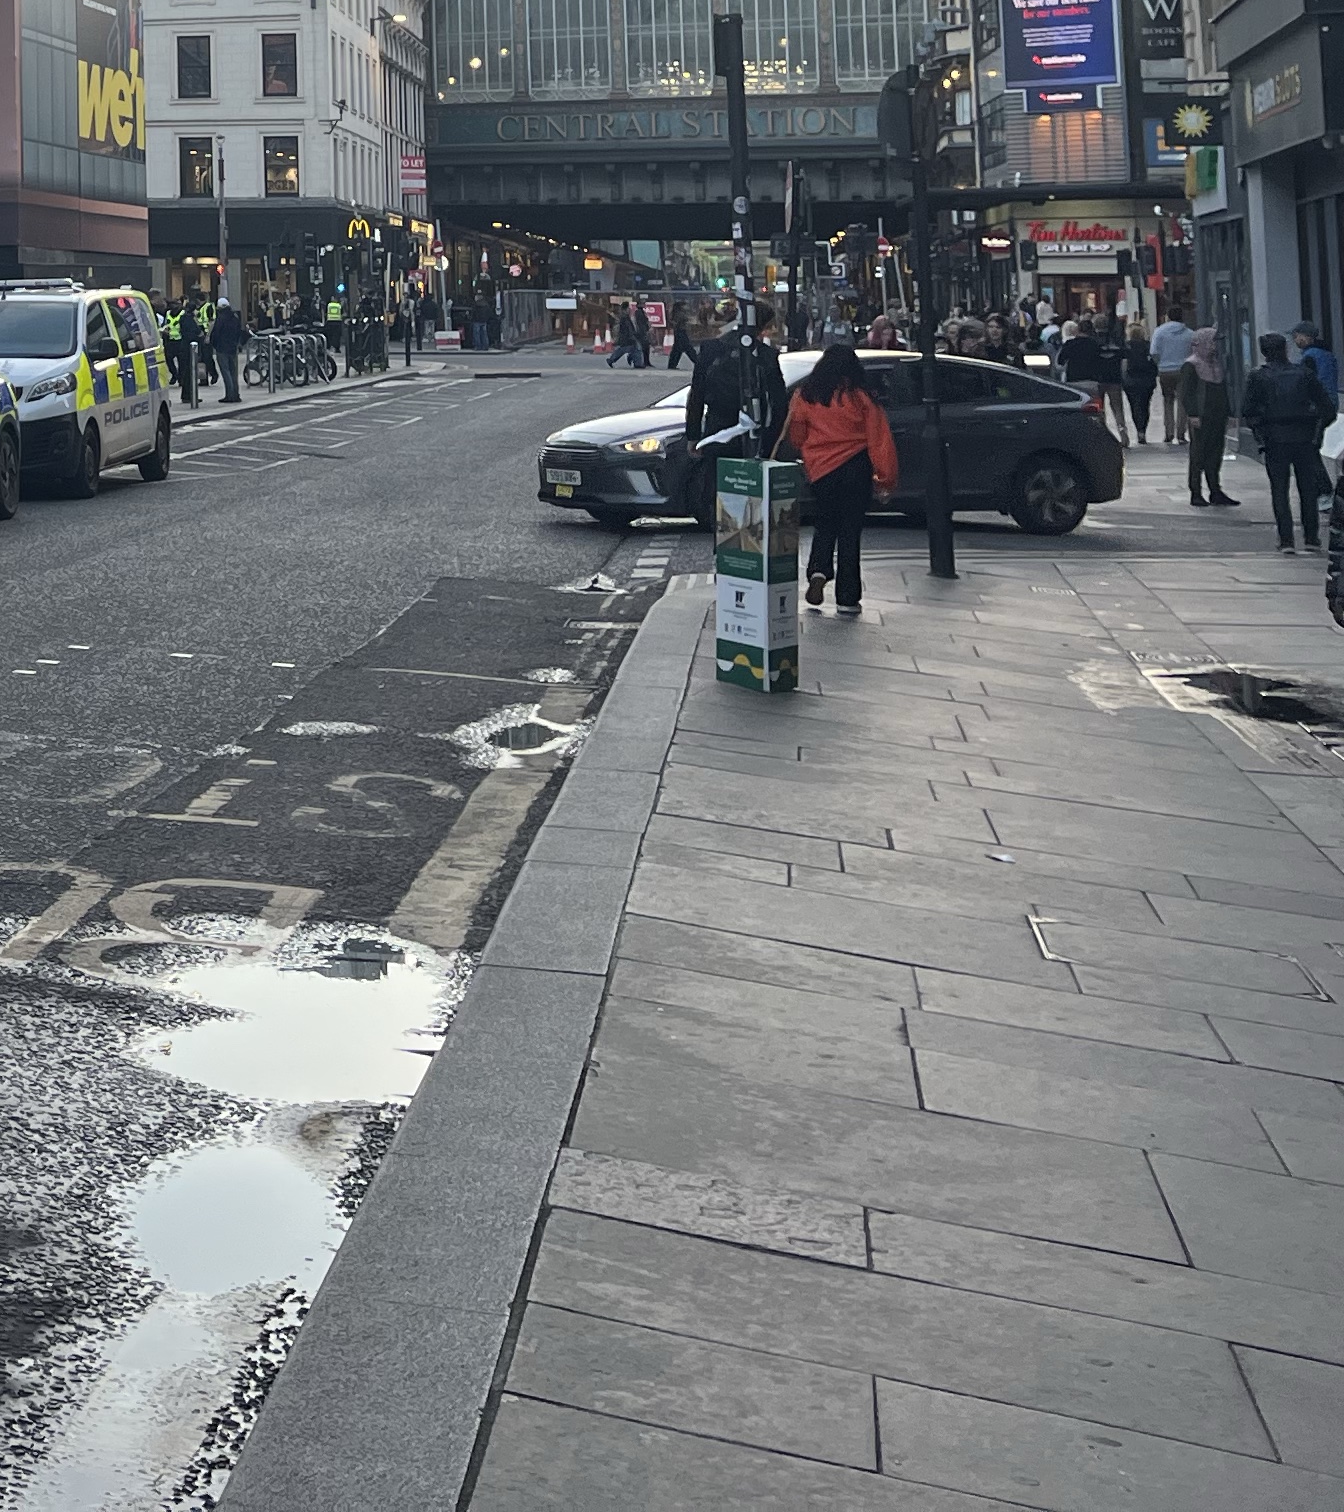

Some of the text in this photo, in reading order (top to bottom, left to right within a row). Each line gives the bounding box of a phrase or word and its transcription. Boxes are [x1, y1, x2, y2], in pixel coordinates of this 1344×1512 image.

[496, 109, 671, 142] CENTRAL
[410, 158, 424, 168] LET
[1025, 219, 1058, 242] Tim
[104, 400, 150, 428] POLICE
